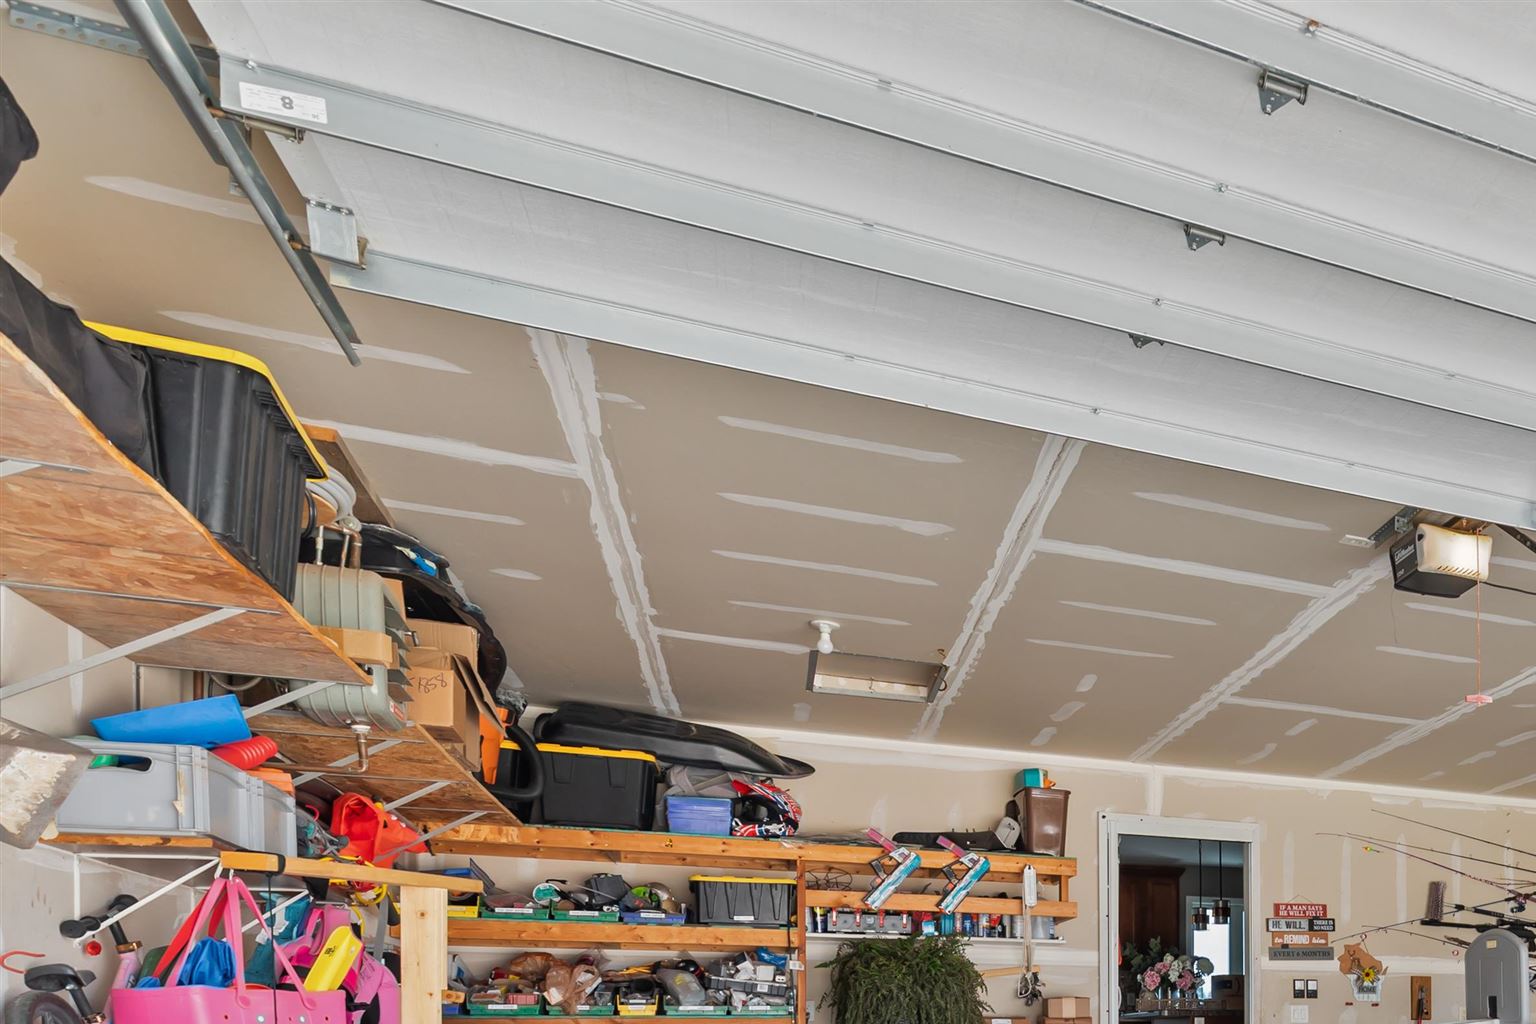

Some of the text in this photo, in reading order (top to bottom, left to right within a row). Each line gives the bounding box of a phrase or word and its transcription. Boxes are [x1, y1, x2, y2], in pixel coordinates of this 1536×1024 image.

[280, 95, 295, 110] 8
[1272, 921, 1282, 929] HE
[1283, 934, 1310, 944] REMIND
